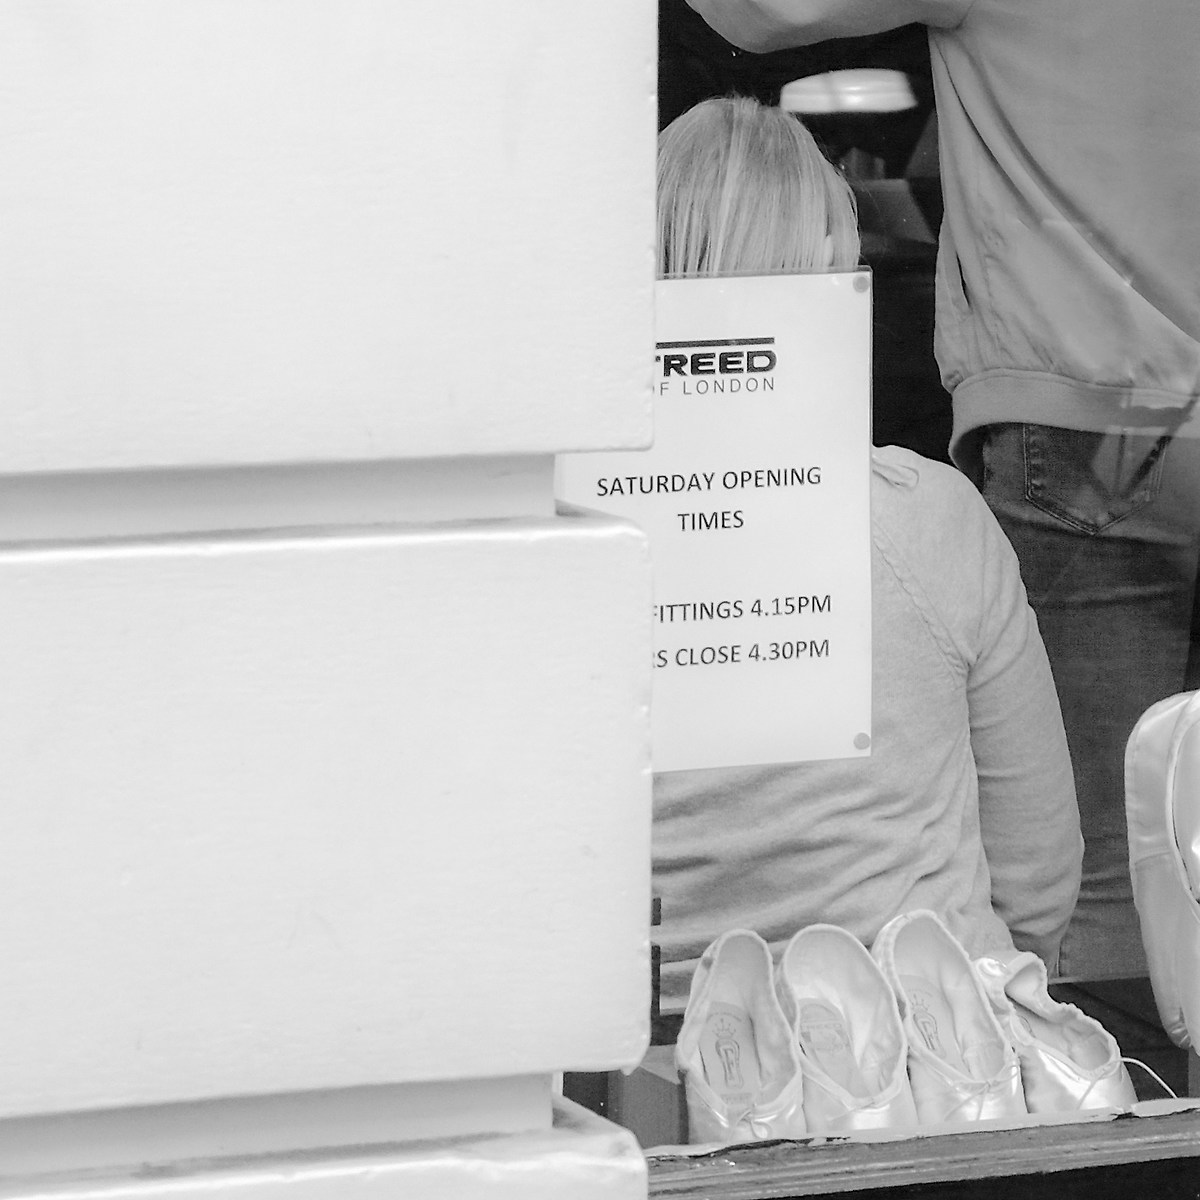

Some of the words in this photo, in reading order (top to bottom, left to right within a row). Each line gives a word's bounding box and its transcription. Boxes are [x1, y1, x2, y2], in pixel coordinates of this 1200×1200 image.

[683, 376, 775, 395] LONDON
[596, 471, 715, 497] SATURDAY
[722, 466, 822, 490] OPENING
[677, 509, 745, 532] TIMES
[653, 599, 743, 624] ITTINGS
[751, 594, 832, 617] 4.15PM
[675, 644, 741, 667] CLOSE
[748, 639, 830, 662] 4.30PM
